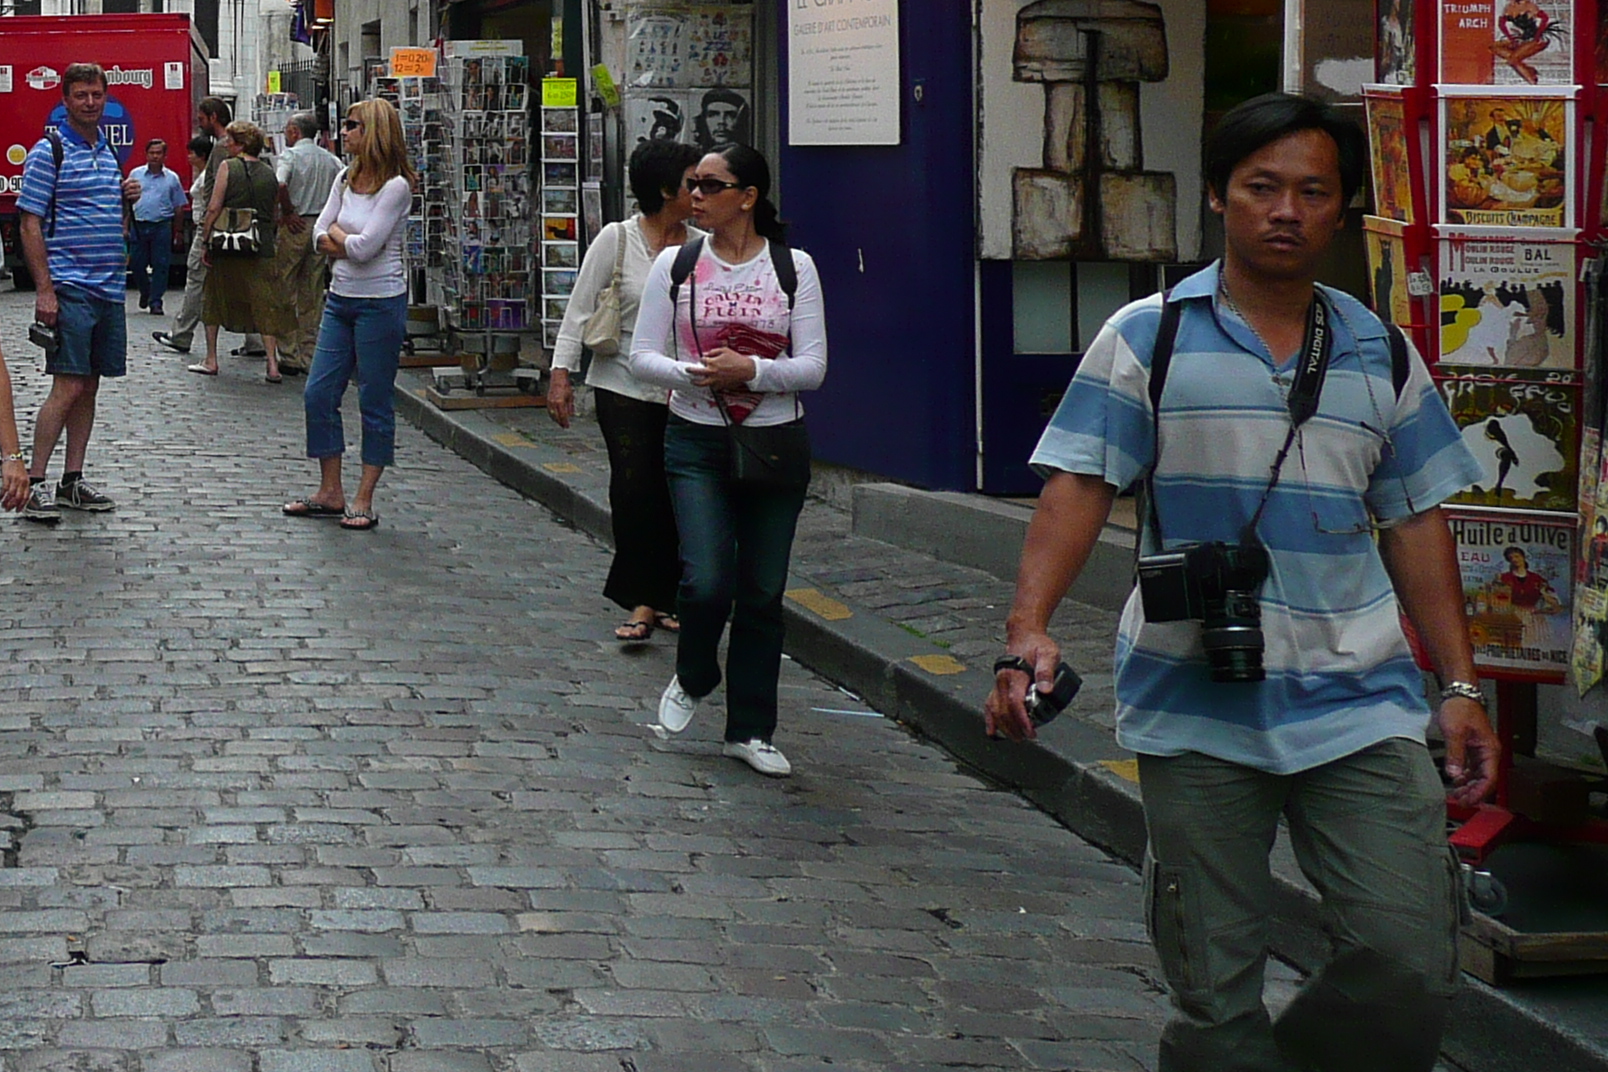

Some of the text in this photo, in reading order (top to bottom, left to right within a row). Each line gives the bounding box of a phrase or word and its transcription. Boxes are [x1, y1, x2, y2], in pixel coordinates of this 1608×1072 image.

[1444, 3, 1491, 14] TRIUMPH
[794, 22, 818, 37] GALERIE
[836, 15, 891, 33] CONTEMPORAIN
[1458, 18, 1488, 28] ARCH
[1465, 210, 1557, 226] BISCUITS CHAMPAGNE
[1524, 248, 1552, 261] BAL
[1490, 266, 1540, 274] GOULUE
[1307, 327, 1324, 374] DIGITAL
[1454, 519, 1504, 545] Huile
